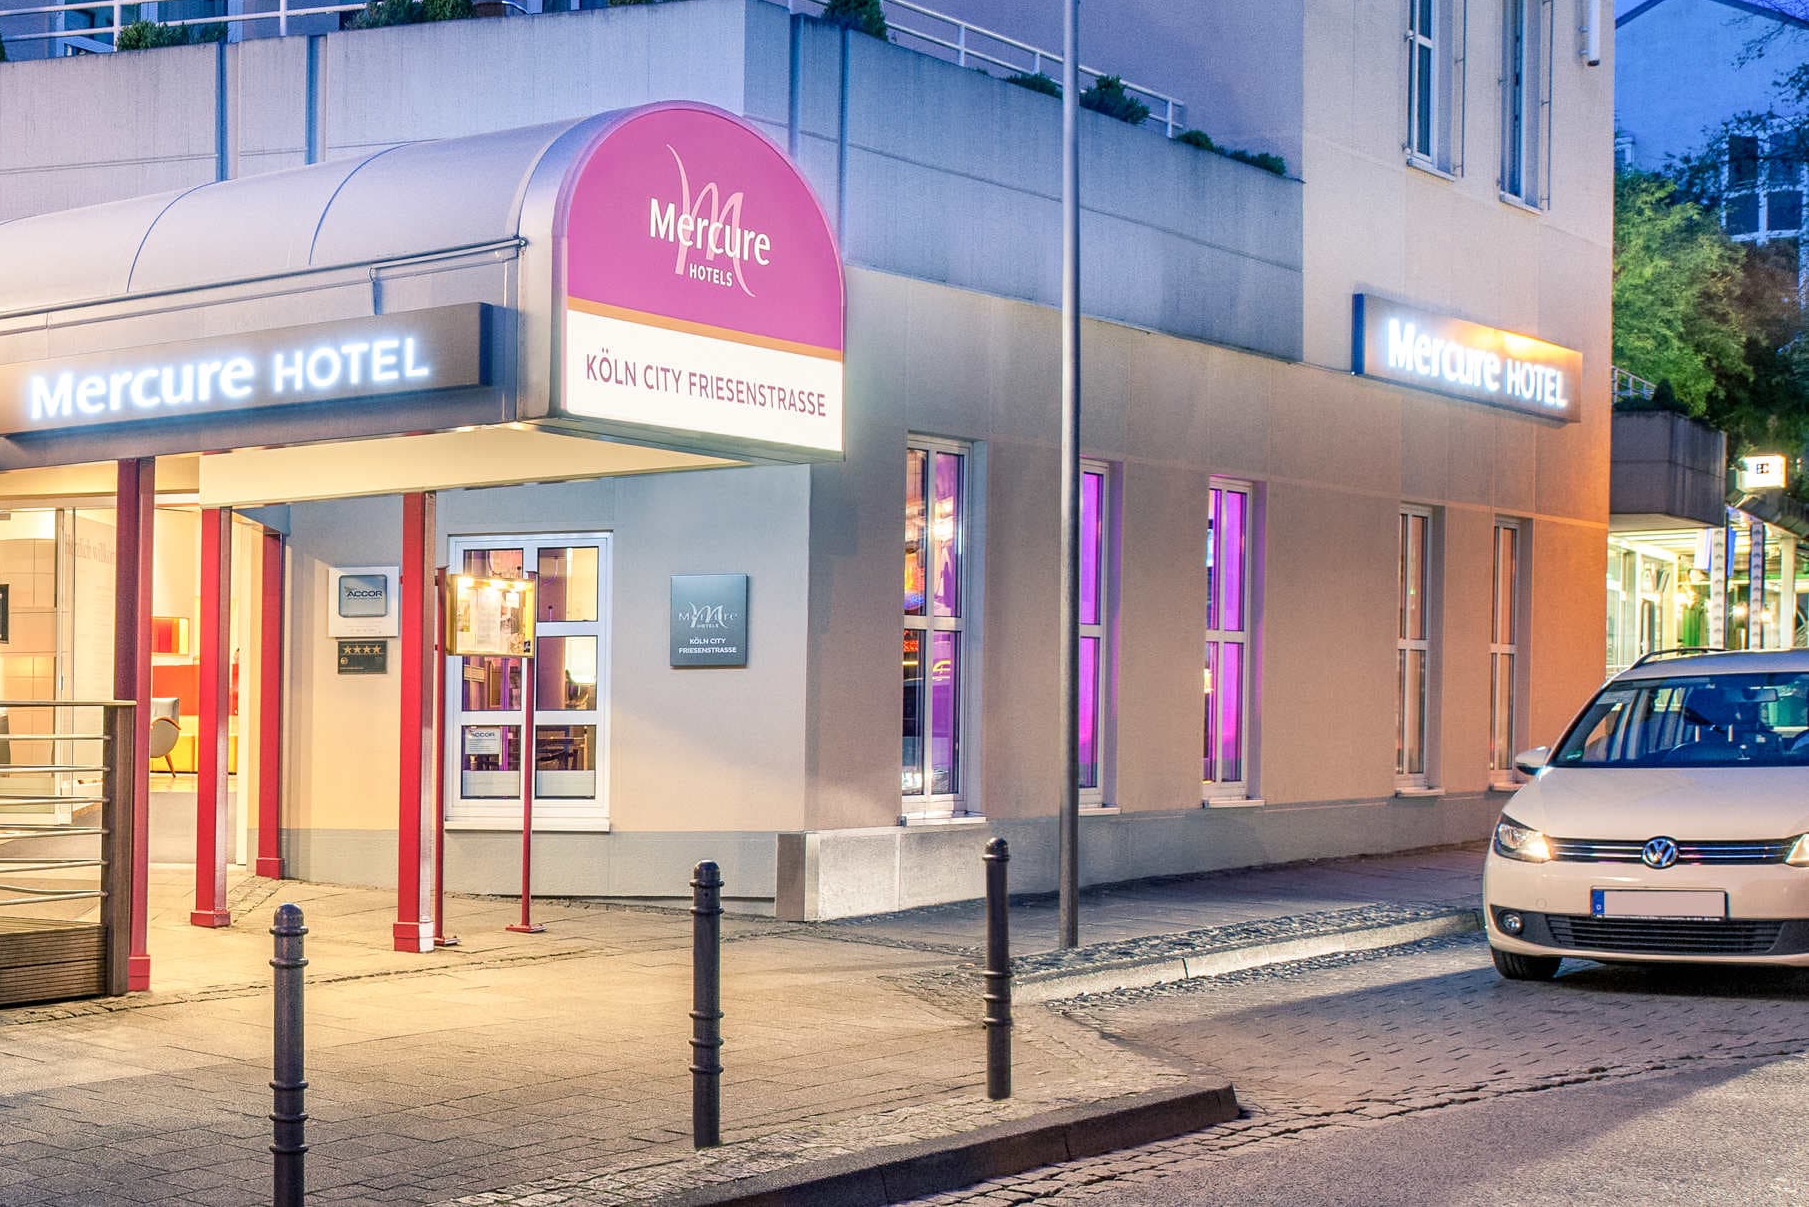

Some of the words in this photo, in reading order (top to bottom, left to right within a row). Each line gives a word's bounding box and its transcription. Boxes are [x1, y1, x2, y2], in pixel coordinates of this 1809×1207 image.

[649, 197, 772, 266] Mercure
[689, 262, 733, 287] HOTELS
[29, 355, 253, 421] Mercure
[273, 337, 429, 394] HOTEL
[586, 347, 637, 387] KÖLN
[643, 364, 682, 394] CITY
[688, 371, 827, 418] FRIESENSTRASSE
[1388, 317, 1502, 392] Mercure
[1505, 358, 1568, 408] HOTEL
[678, 646, 737, 654] FRIESENSTRASSE
[689, 636, 709, 645] KÖLN
[709, 637, 727, 645] CITY
